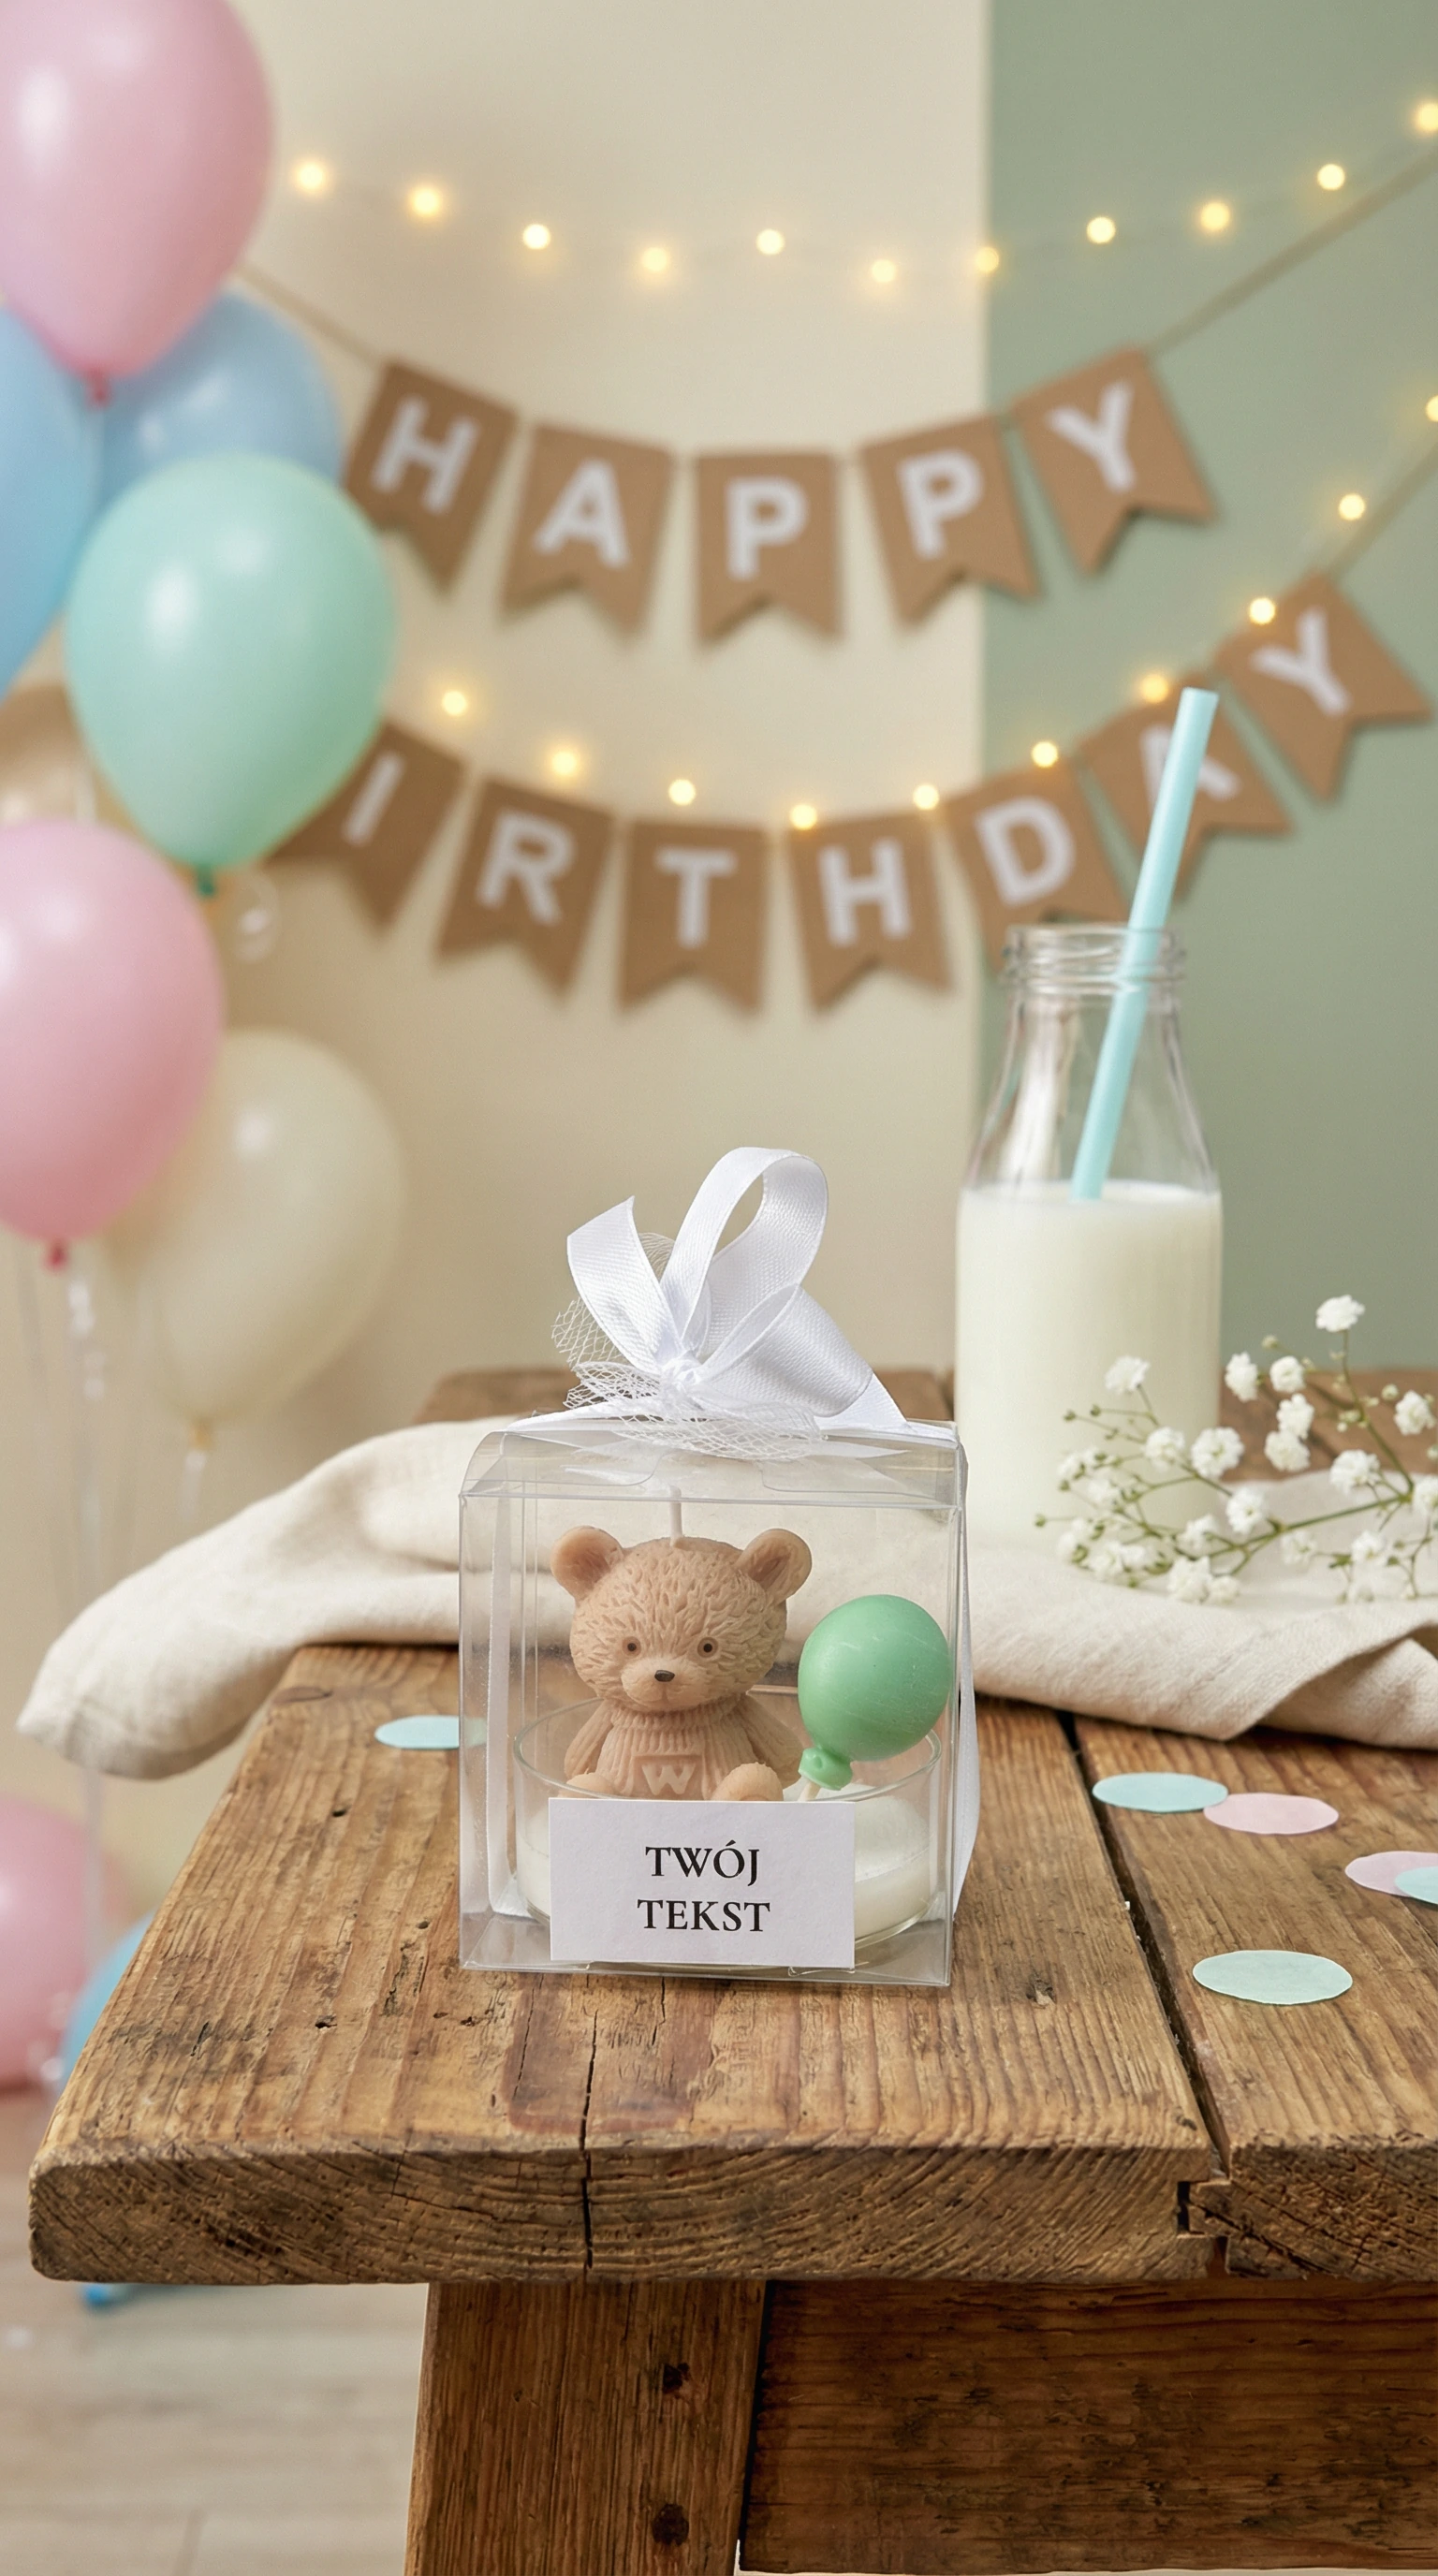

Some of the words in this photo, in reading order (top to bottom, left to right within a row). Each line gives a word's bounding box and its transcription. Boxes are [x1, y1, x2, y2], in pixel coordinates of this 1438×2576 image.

[373, 378, 1134, 580] HAPPY
[343, 607, 1351, 949] IRTHDAY
[641, 1762, 697, 1795] W
[645, 1839, 760, 1887] TWÓJ
[637, 1898, 770, 1932] TEKST
